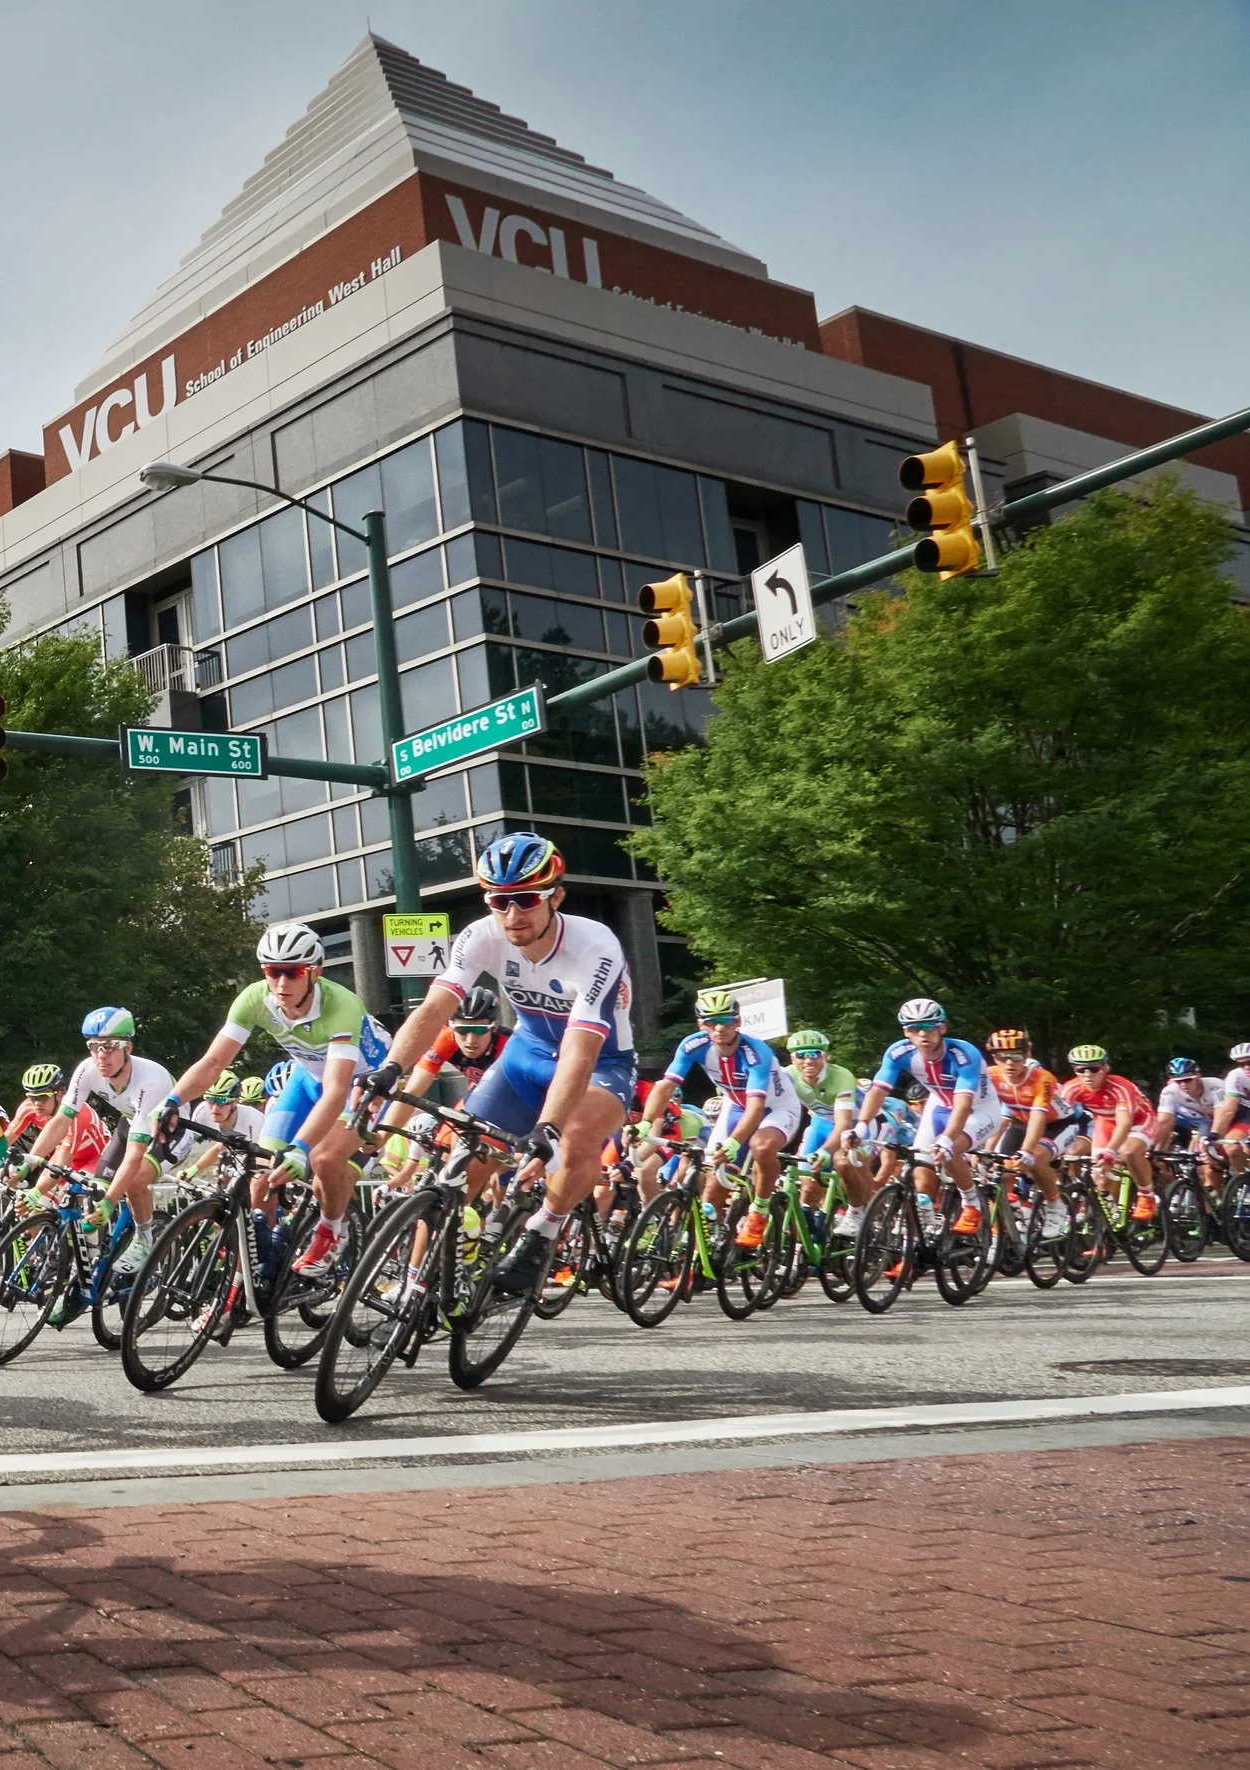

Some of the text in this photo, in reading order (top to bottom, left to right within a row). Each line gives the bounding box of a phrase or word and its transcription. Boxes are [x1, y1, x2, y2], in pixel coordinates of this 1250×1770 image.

[445, 194, 602, 288] VCU
[185, 245, 403, 399] School of Engineering West Hall
[58, 354, 178, 473] VCU
[770, 617, 804, 650] ONLY
[137, 734, 251, 759] W. Main St
[400, 700, 531, 762] S Belvidere St N
[400, 718, 535, 777] 00 00
[138, 755, 252, 770] 500 600
[390, 918, 423, 927] TURNING
[390, 927, 424, 936] VEHICLES
[584, 957, 613, 1006] Santini
[510, 988, 573, 1013] OVAK
[743, 1012, 766, 1027] KM
